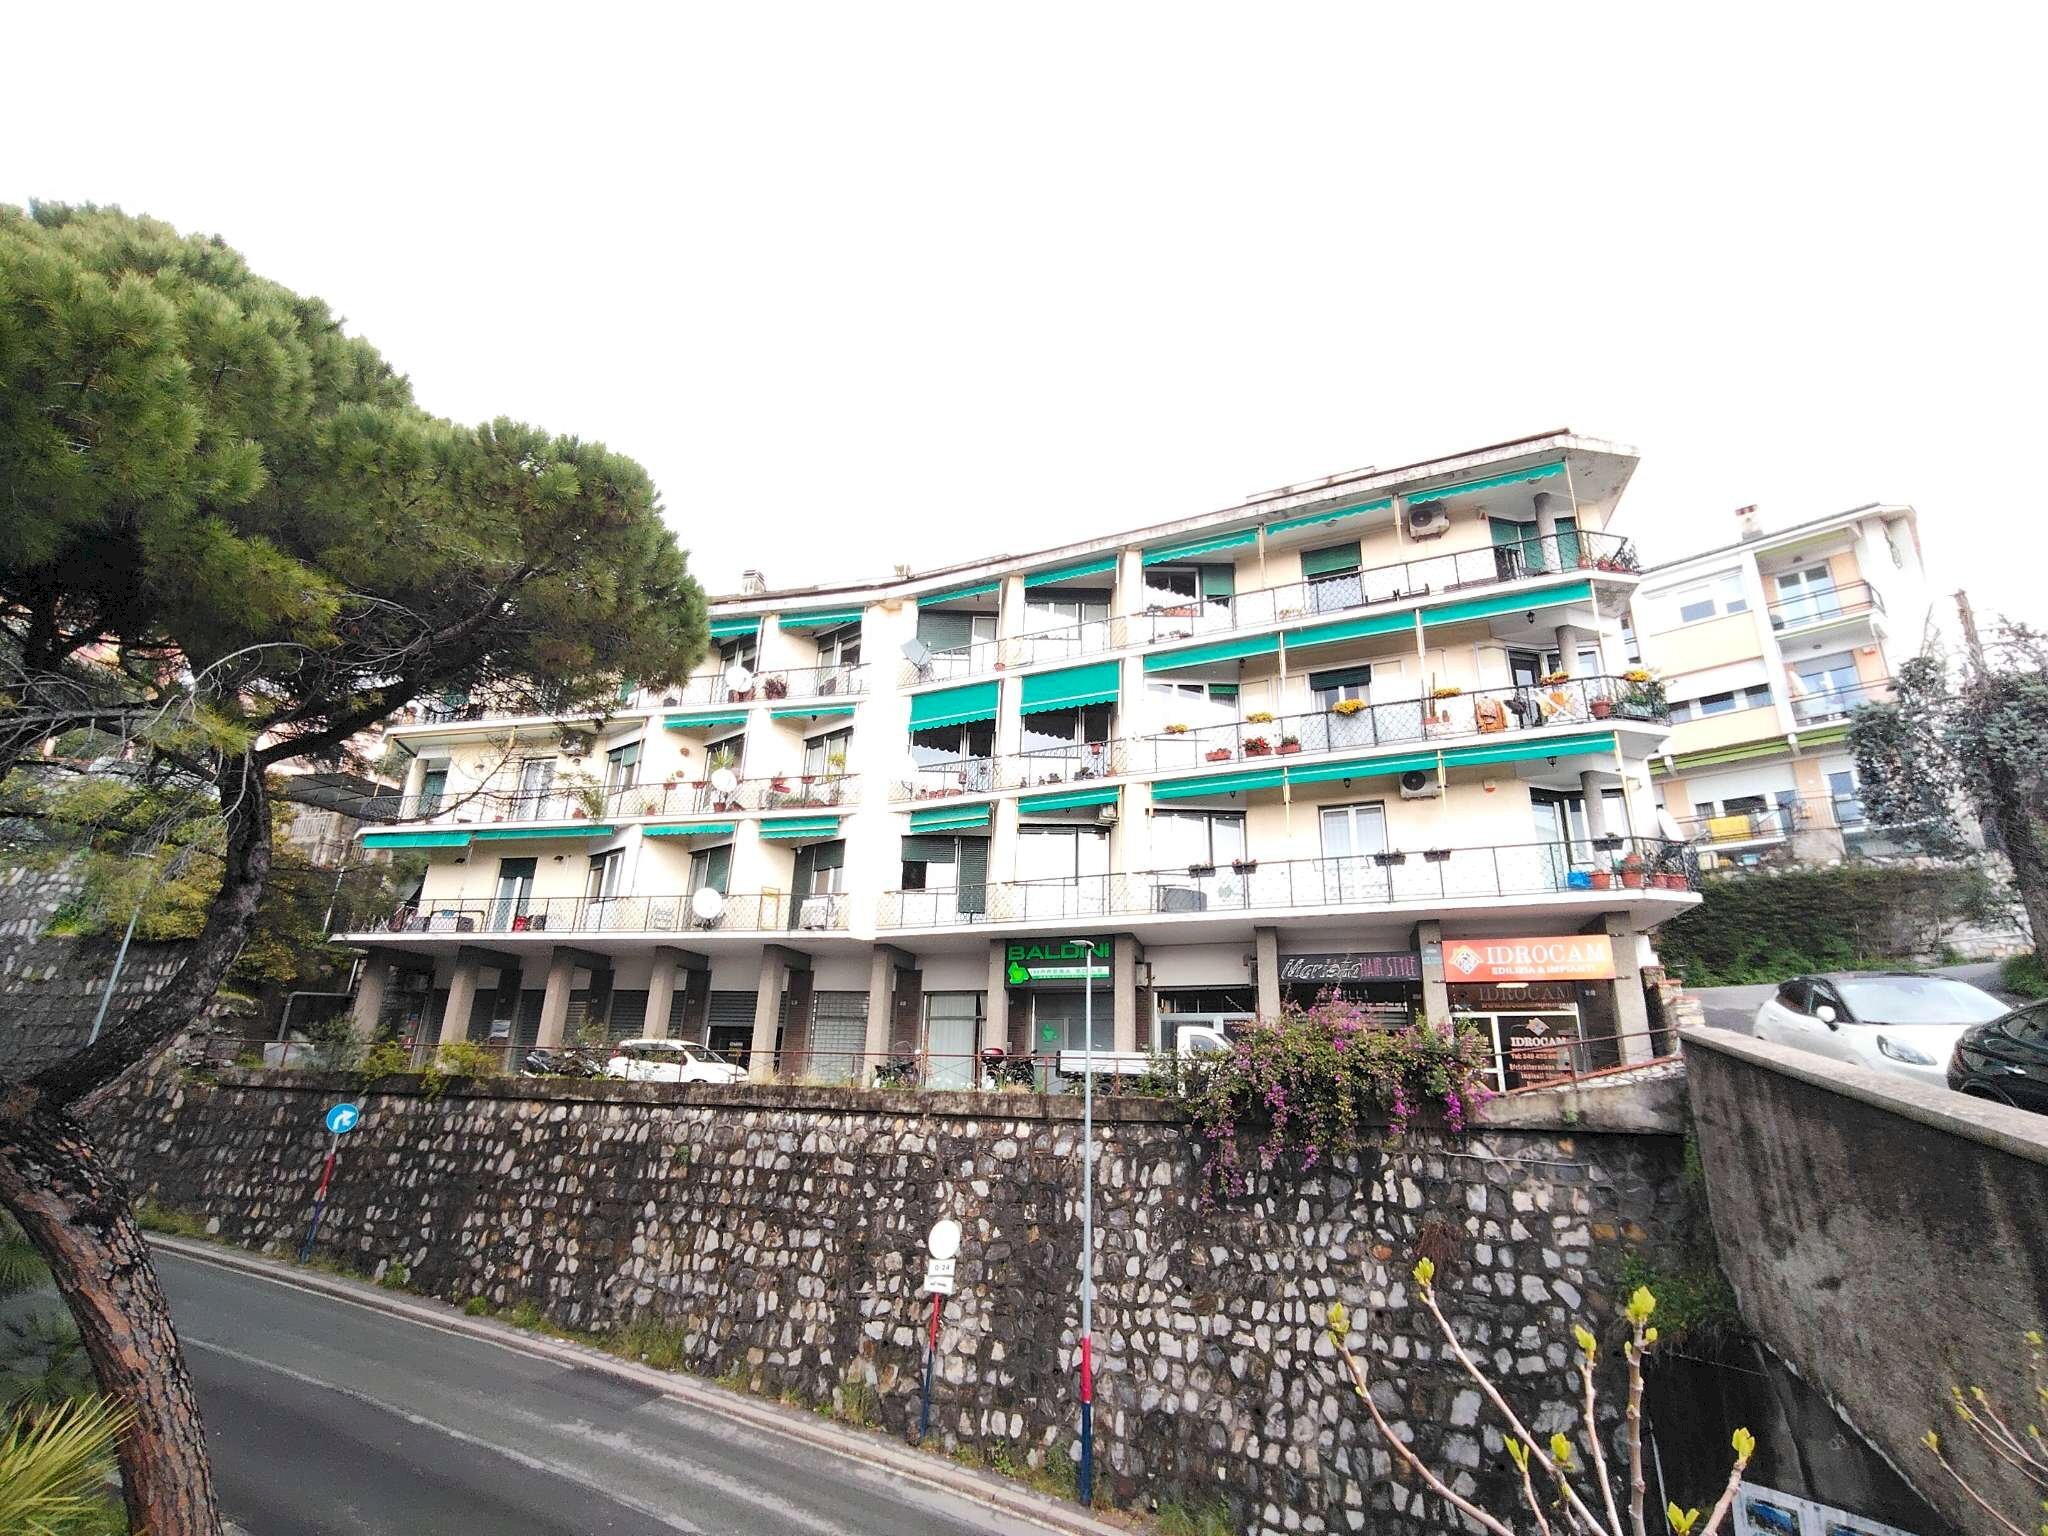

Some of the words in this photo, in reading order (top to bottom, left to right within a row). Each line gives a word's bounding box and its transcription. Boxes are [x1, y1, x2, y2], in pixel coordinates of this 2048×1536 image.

[1008, 942, 1110, 960] BALDINI
[1486, 943, 1607, 965] IDROCAM
[1387, 956, 1416, 977] STYLE
[1491, 967, 1536, 975] EDILIZIA
[1478, 986, 1571, 1001] IDROCAM
[1510, 1036, 1566, 1047] IDROCAM
